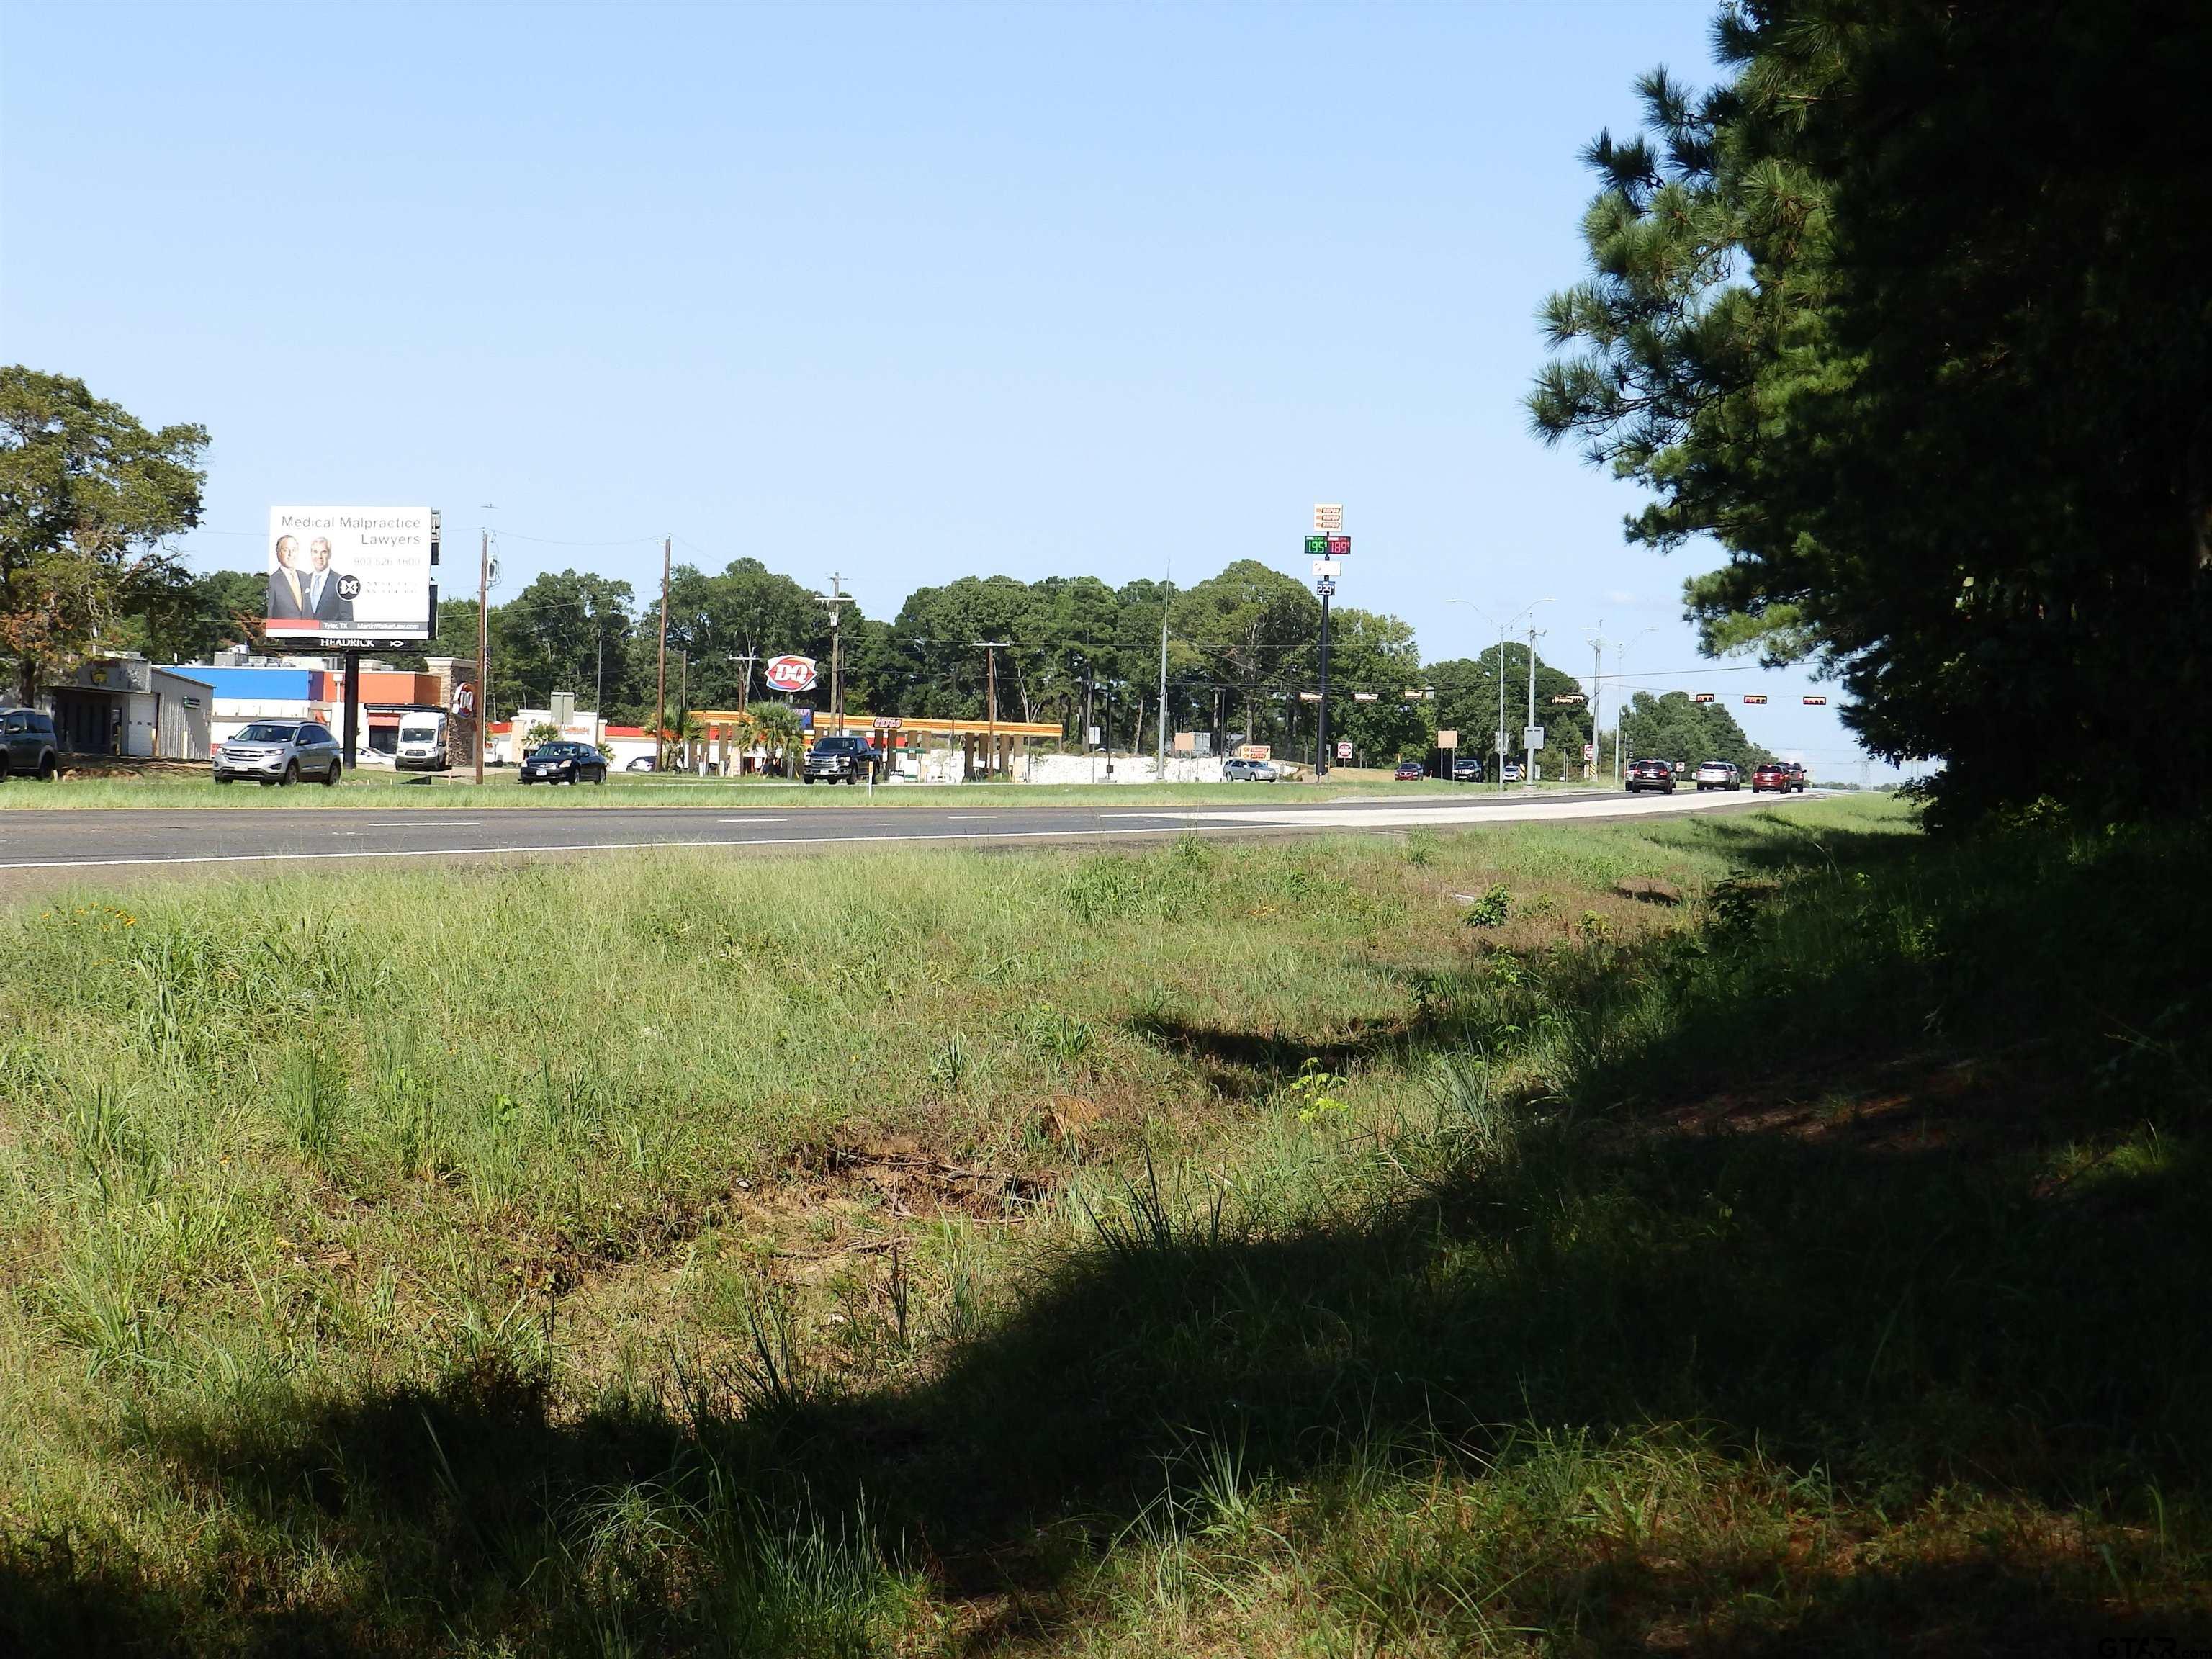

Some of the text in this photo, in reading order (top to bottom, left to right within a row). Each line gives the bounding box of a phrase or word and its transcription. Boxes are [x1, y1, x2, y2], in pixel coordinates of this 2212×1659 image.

[282, 516, 421, 529] Medical Malpractice
[361, 534, 421, 547] Lawyers
[773, 663, 808, 685] DQ
